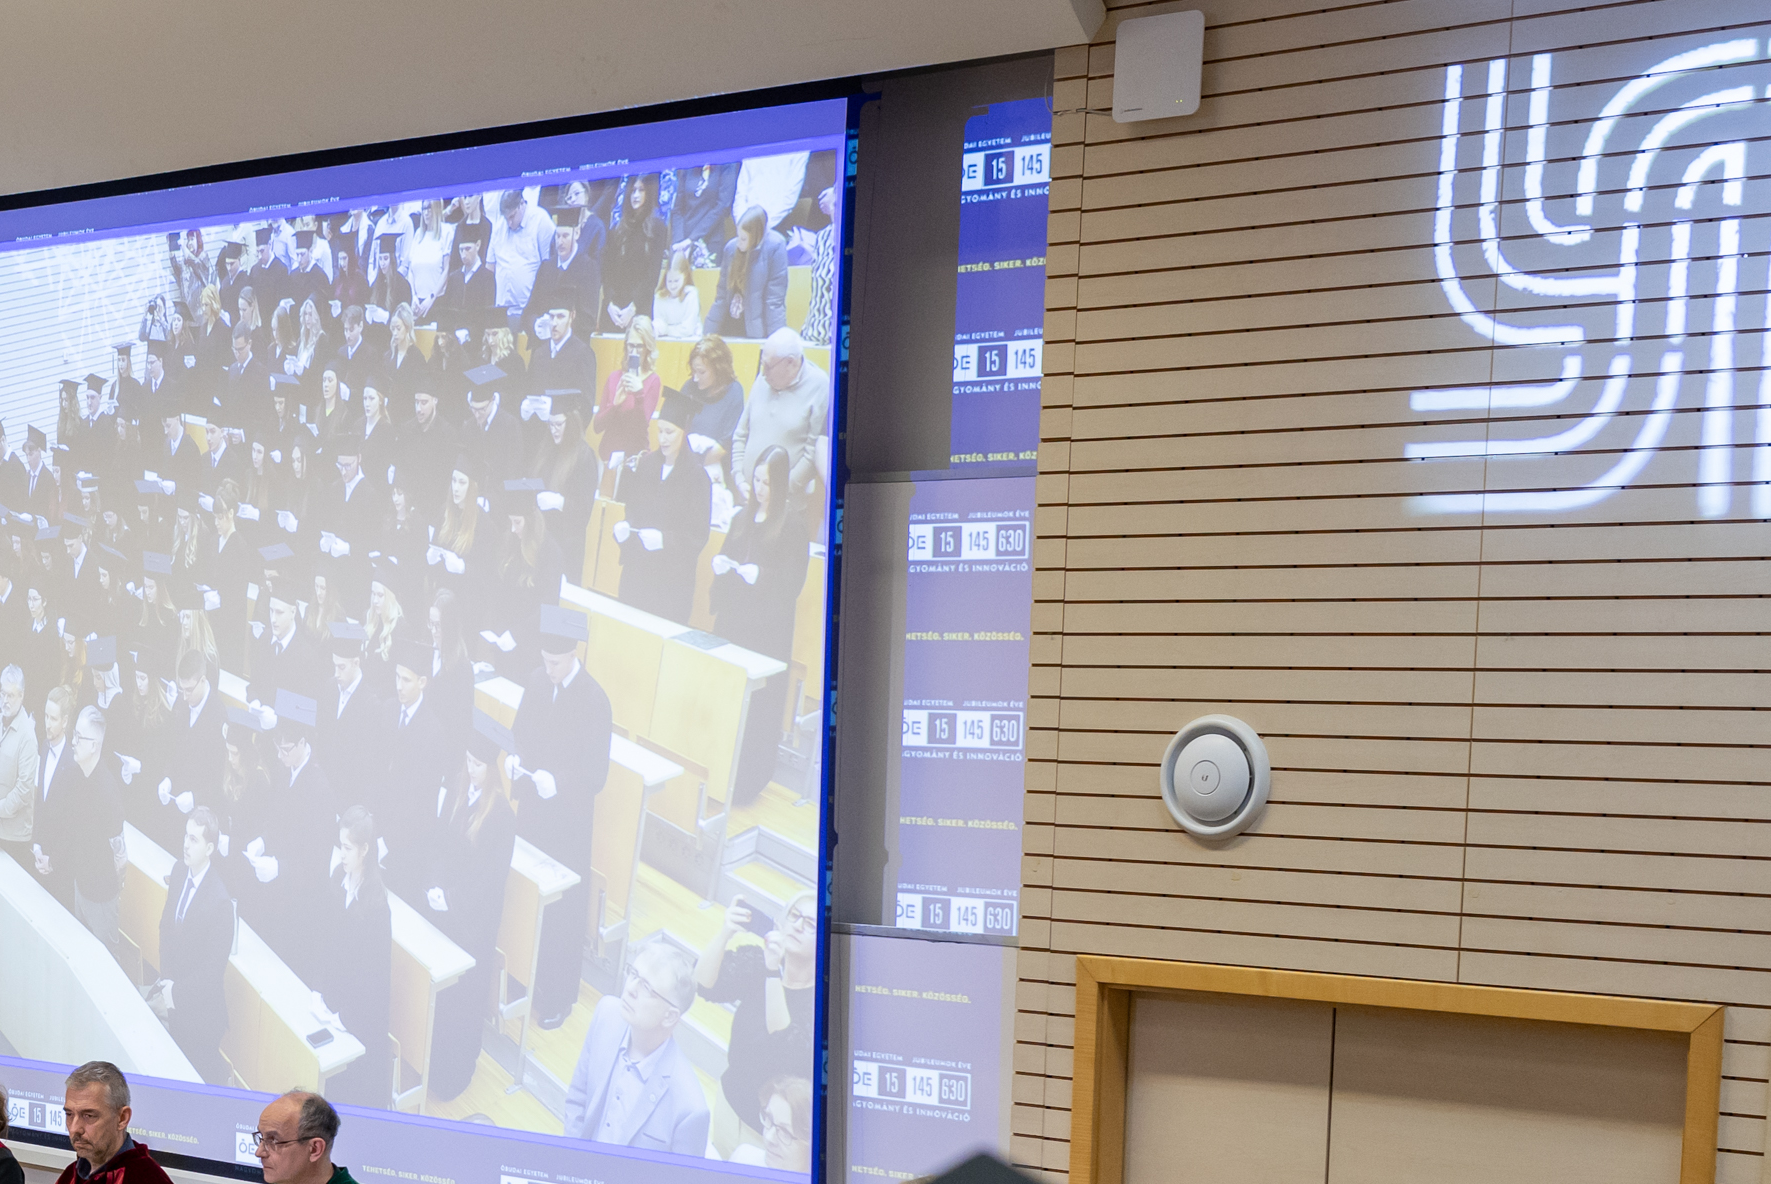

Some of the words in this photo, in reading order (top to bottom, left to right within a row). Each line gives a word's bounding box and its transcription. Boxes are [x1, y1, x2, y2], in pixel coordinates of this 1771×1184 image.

[991, 157, 1007, 180] 15
[1021, 153, 1043, 177] 145
[1010, 188, 1022, 199] ÉS
[984, 350, 1000, 372] 15
[1014, 348, 1035, 370] 145
[1003, 382, 1015, 392] ÉS
[926, 511, 959, 520] EGYETEM
[939, 531, 954, 553] 15
[968, 531, 990, 551] 145
[998, 529, 1024, 552] 630
[958, 563, 969, 572] ÉS
[972, 561, 1028, 572] INNOVÁCIÓ
[1010, 700, 1024, 708] ÉVE
[934, 718, 949, 739] 15
[962, 719, 984, 740] 145
[992, 719, 1018, 742] 630
[902, 749, 950, 759] GYOMÁNY
[953, 750, 964, 759] ÉS
[966, 752, 1023, 762] INNOVÁCIÓ
[916, 883, 948, 892] EGYETEM
[1003, 888, 1018, 897] ÉVE
[929, 903, 943, 924] 15
[956, 905, 977, 927] 145
[986, 907, 1011, 930] 630
[872, 1051, 903, 1061] EGYETEM
[958, 1061, 971, 1069] ÉVE
[885, 1072, 899, 1093] 15
[912, 1075, 932, 1097] 145
[941, 1078, 966, 1102] 630
[33, 1107, 42, 1123] 15
[50, 1109, 62, 1127] 145
[852, 1100, 901, 1113] GYOMÁNY
[903, 1104, 913, 1114] ÉS
[916, 1108, 970, 1122] INNOVÁCIÓ
[523, 1169, 549, 1179] EGYETEM
